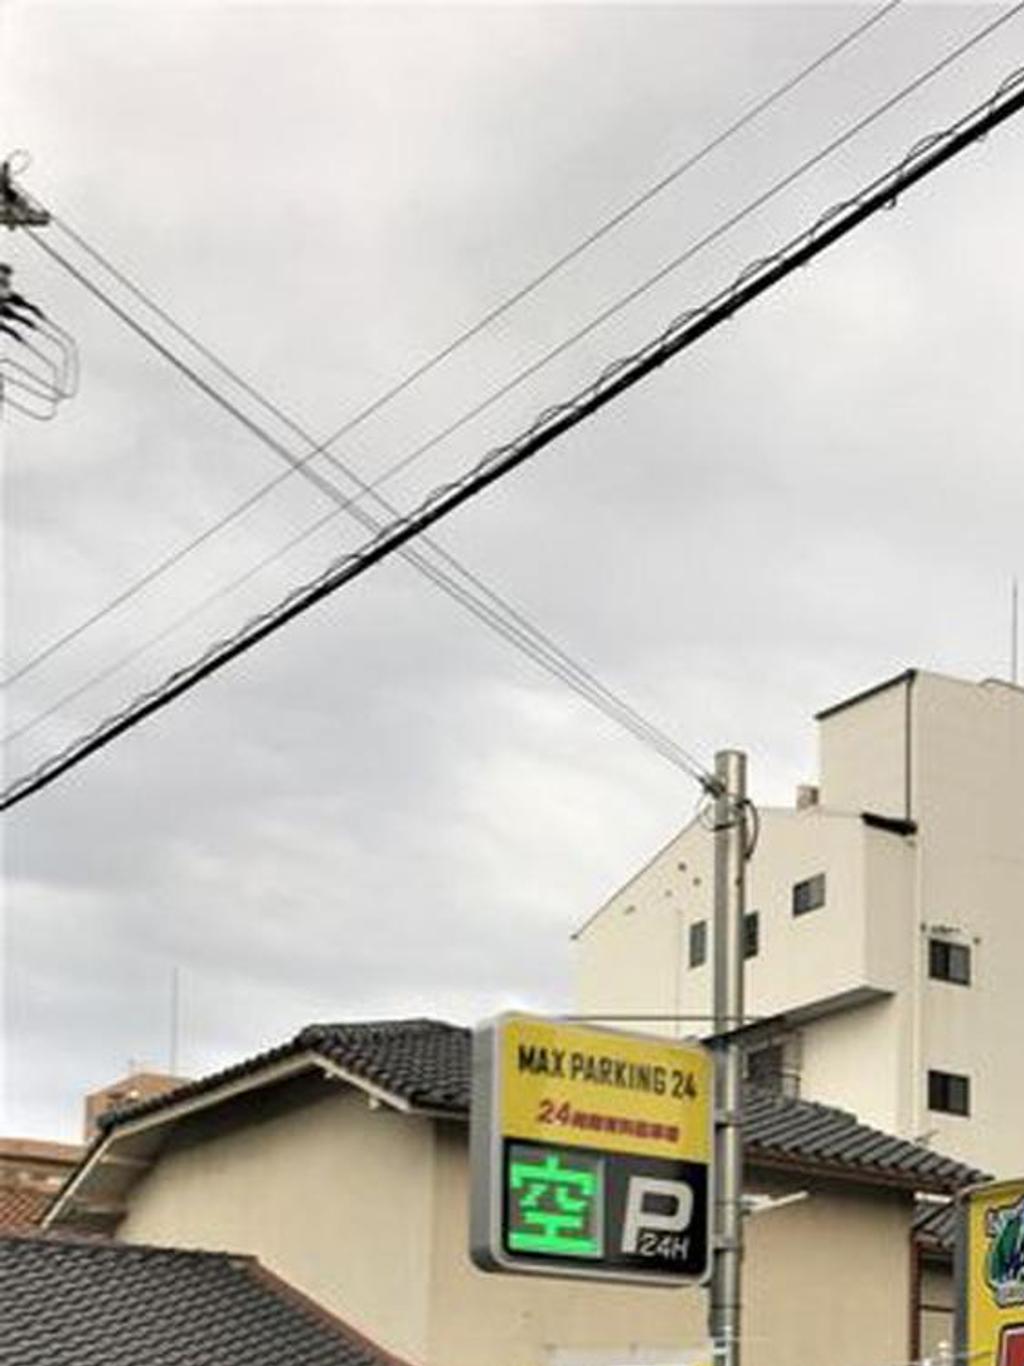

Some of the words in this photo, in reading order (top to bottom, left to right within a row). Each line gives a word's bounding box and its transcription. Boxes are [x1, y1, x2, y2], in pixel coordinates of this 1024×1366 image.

[517, 1044, 565, 1078] MAX
[570, 1052, 668, 1095] PARKING
[671, 1071, 698, 1100] 24
[509, 1154, 602, 1258] 空
[621, 1176, 694, 1254] P
[639, 1233, 690, 1260] 24H
